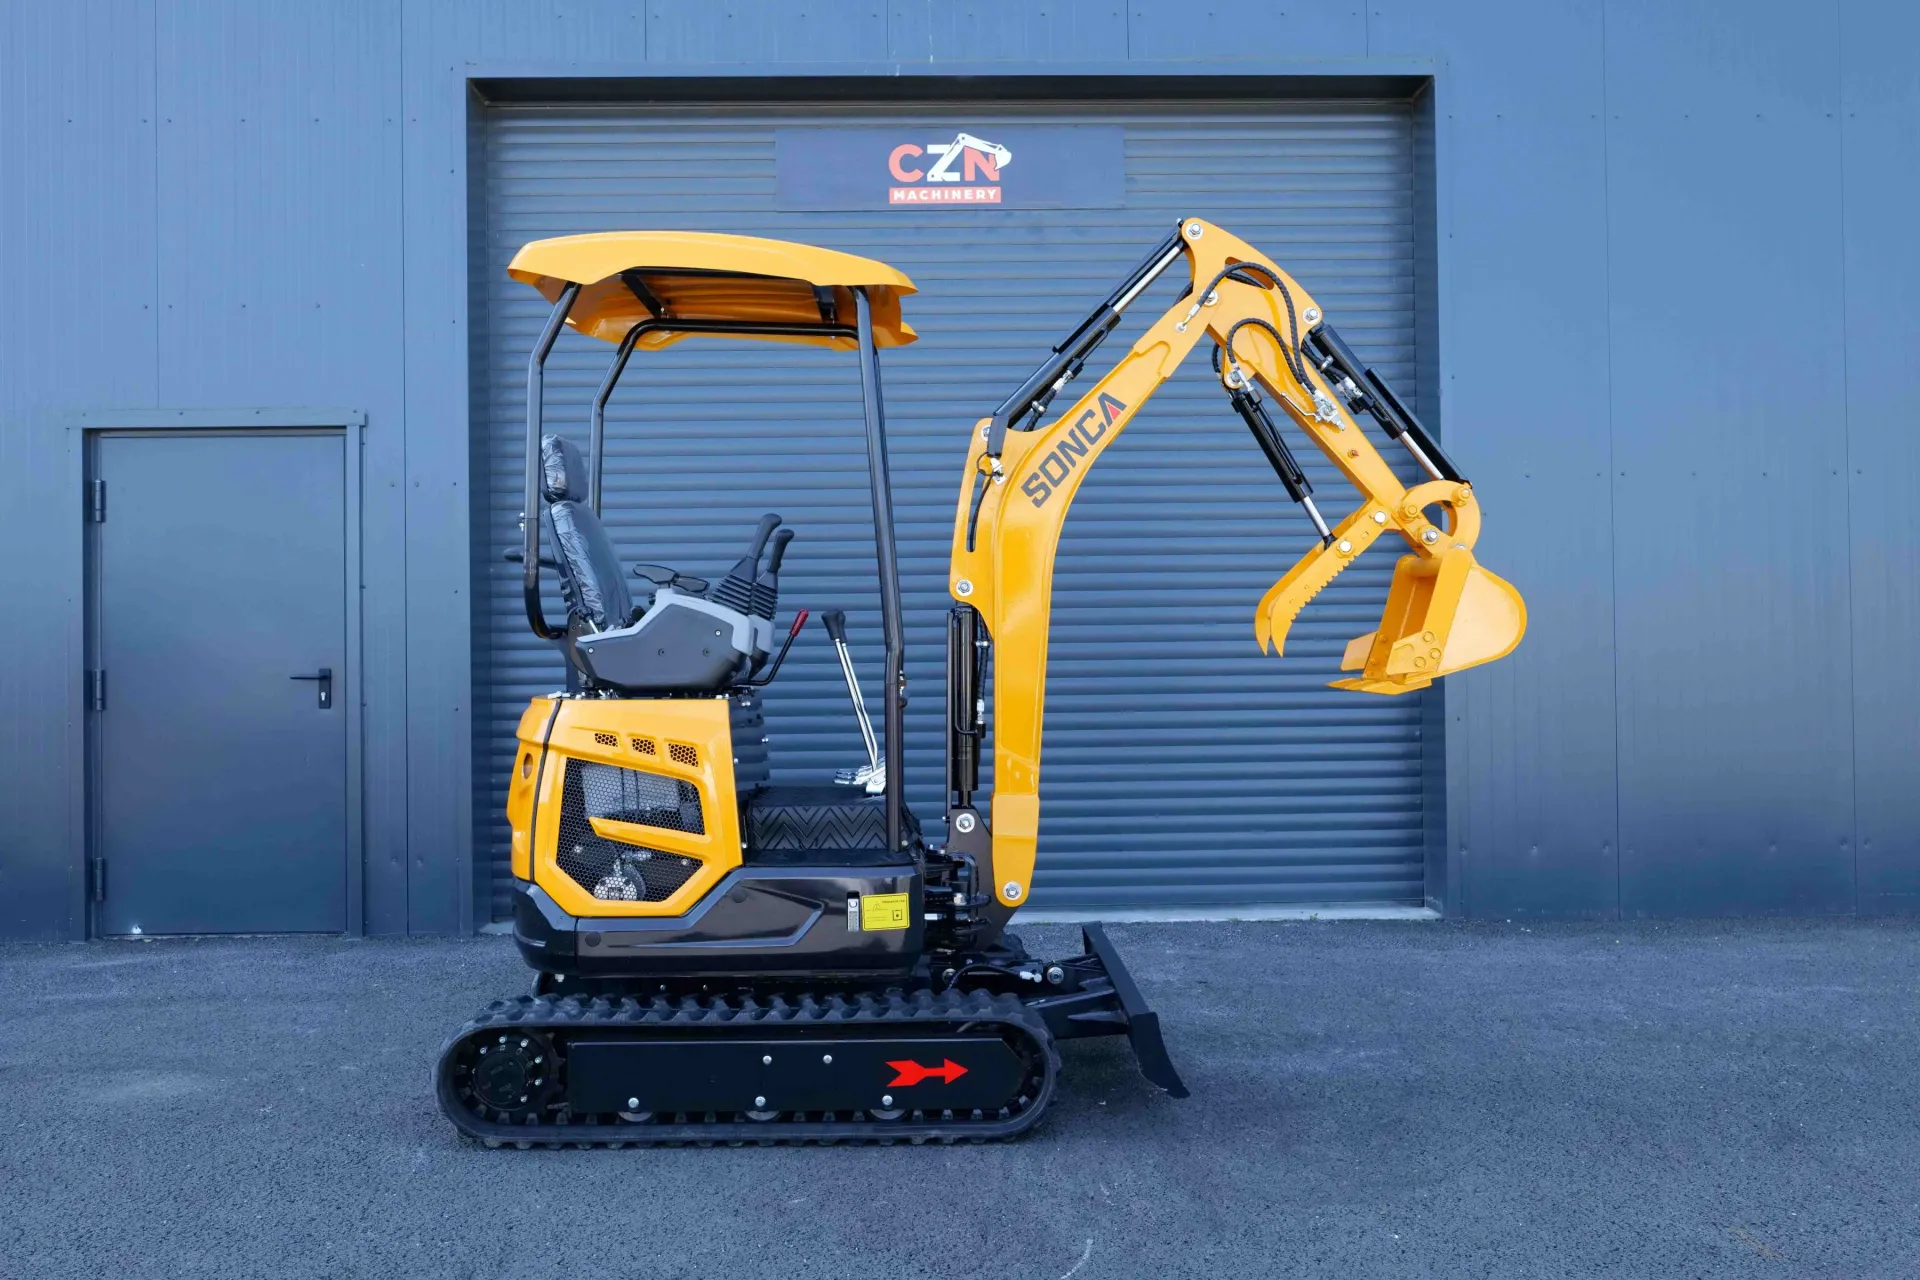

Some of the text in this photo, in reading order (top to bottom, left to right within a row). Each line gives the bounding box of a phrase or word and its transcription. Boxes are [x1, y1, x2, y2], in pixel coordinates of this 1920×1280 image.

[889, 144, 1000, 182] CZN
[894, 189, 997, 200] MACHINERY
[1021, 392, 1127, 508] SONCA
